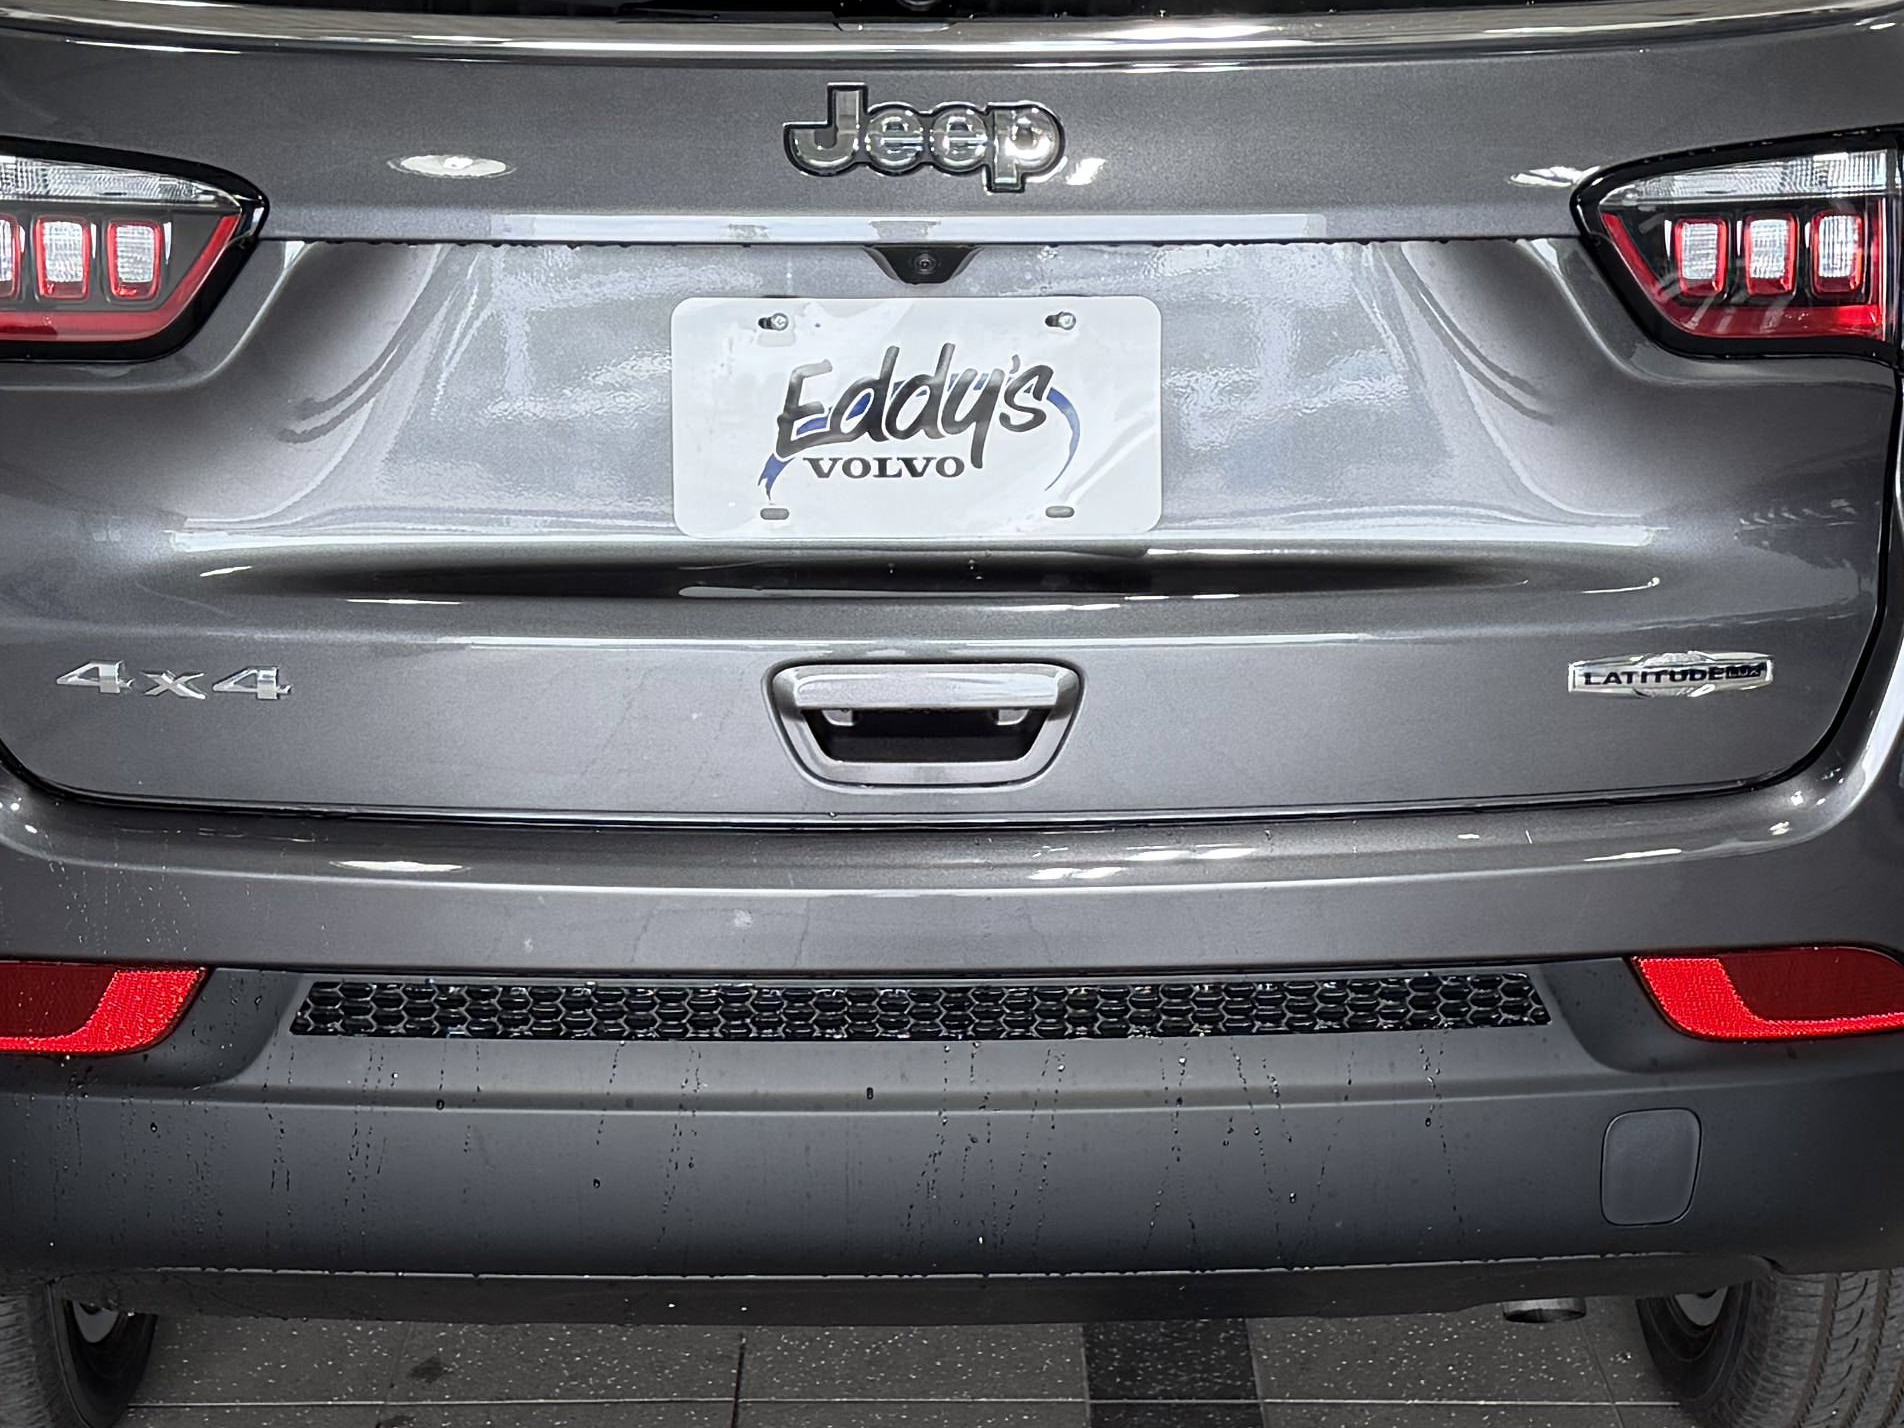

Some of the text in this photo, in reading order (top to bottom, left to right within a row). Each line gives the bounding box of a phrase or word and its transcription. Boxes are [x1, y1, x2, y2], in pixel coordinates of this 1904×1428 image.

[783, 83, 1066, 193] Jeep
[775, 342, 1054, 470] Eddy's
[802, 455, 966, 479] VOLVO
[1583, 666, 1725, 686] LATITUDE
